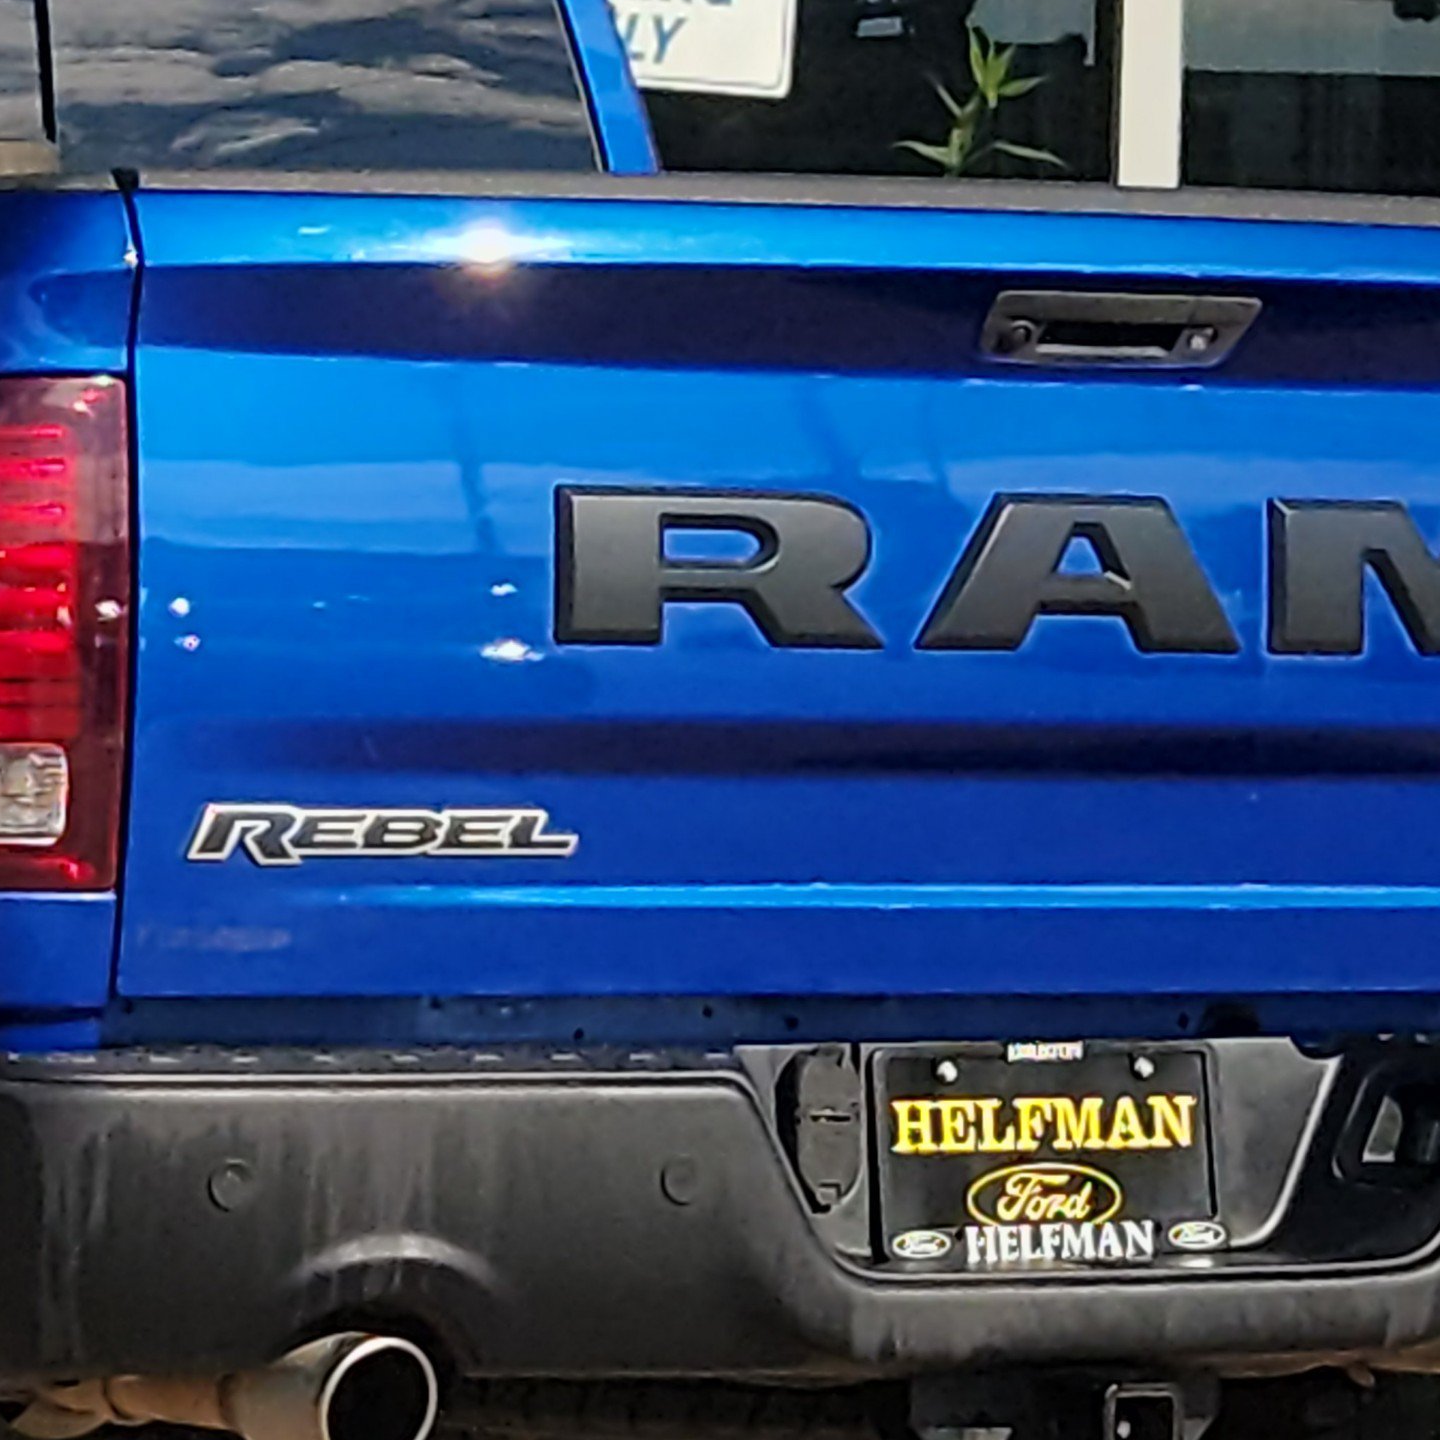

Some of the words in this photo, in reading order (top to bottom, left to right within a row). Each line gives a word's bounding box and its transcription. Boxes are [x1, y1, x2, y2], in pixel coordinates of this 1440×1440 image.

[186, 801, 580, 866] REBEL
[890, 1094, 1198, 1154] HELFMAN
[996, 1171, 1094, 1221] Ford
[964, 1219, 1156, 1264] HELFMAN
